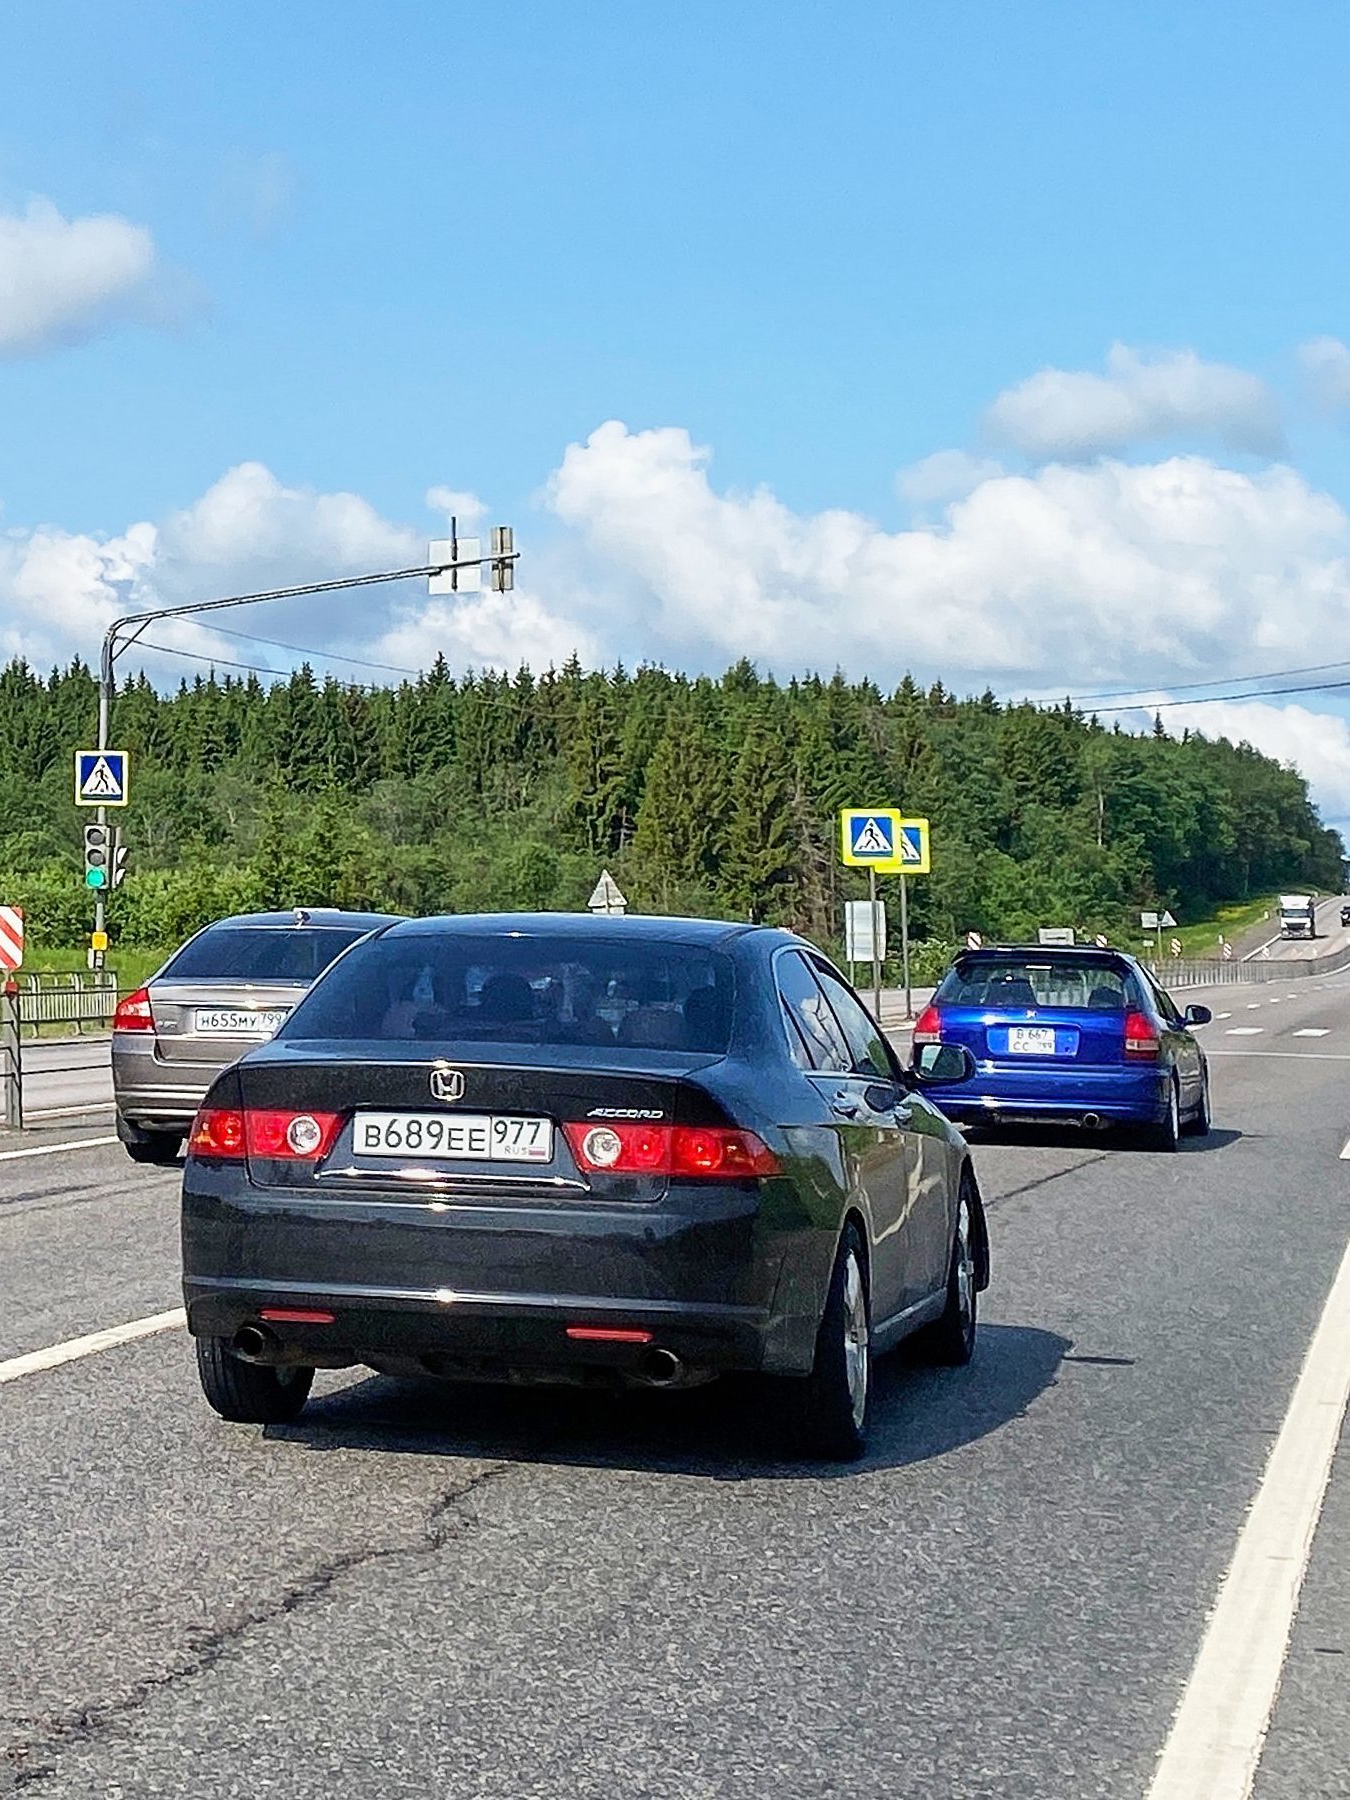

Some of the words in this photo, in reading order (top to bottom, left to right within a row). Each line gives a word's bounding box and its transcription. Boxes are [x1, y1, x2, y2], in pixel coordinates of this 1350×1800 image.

[201, 1013, 257, 1028] Н655МУ
[586, 1107, 664, 1119] ACCORD
[364, 1119, 486, 1152] В689ЕЕ
[493, 1120, 541, 1146] 977
[505, 1145, 528, 1156] RUS
